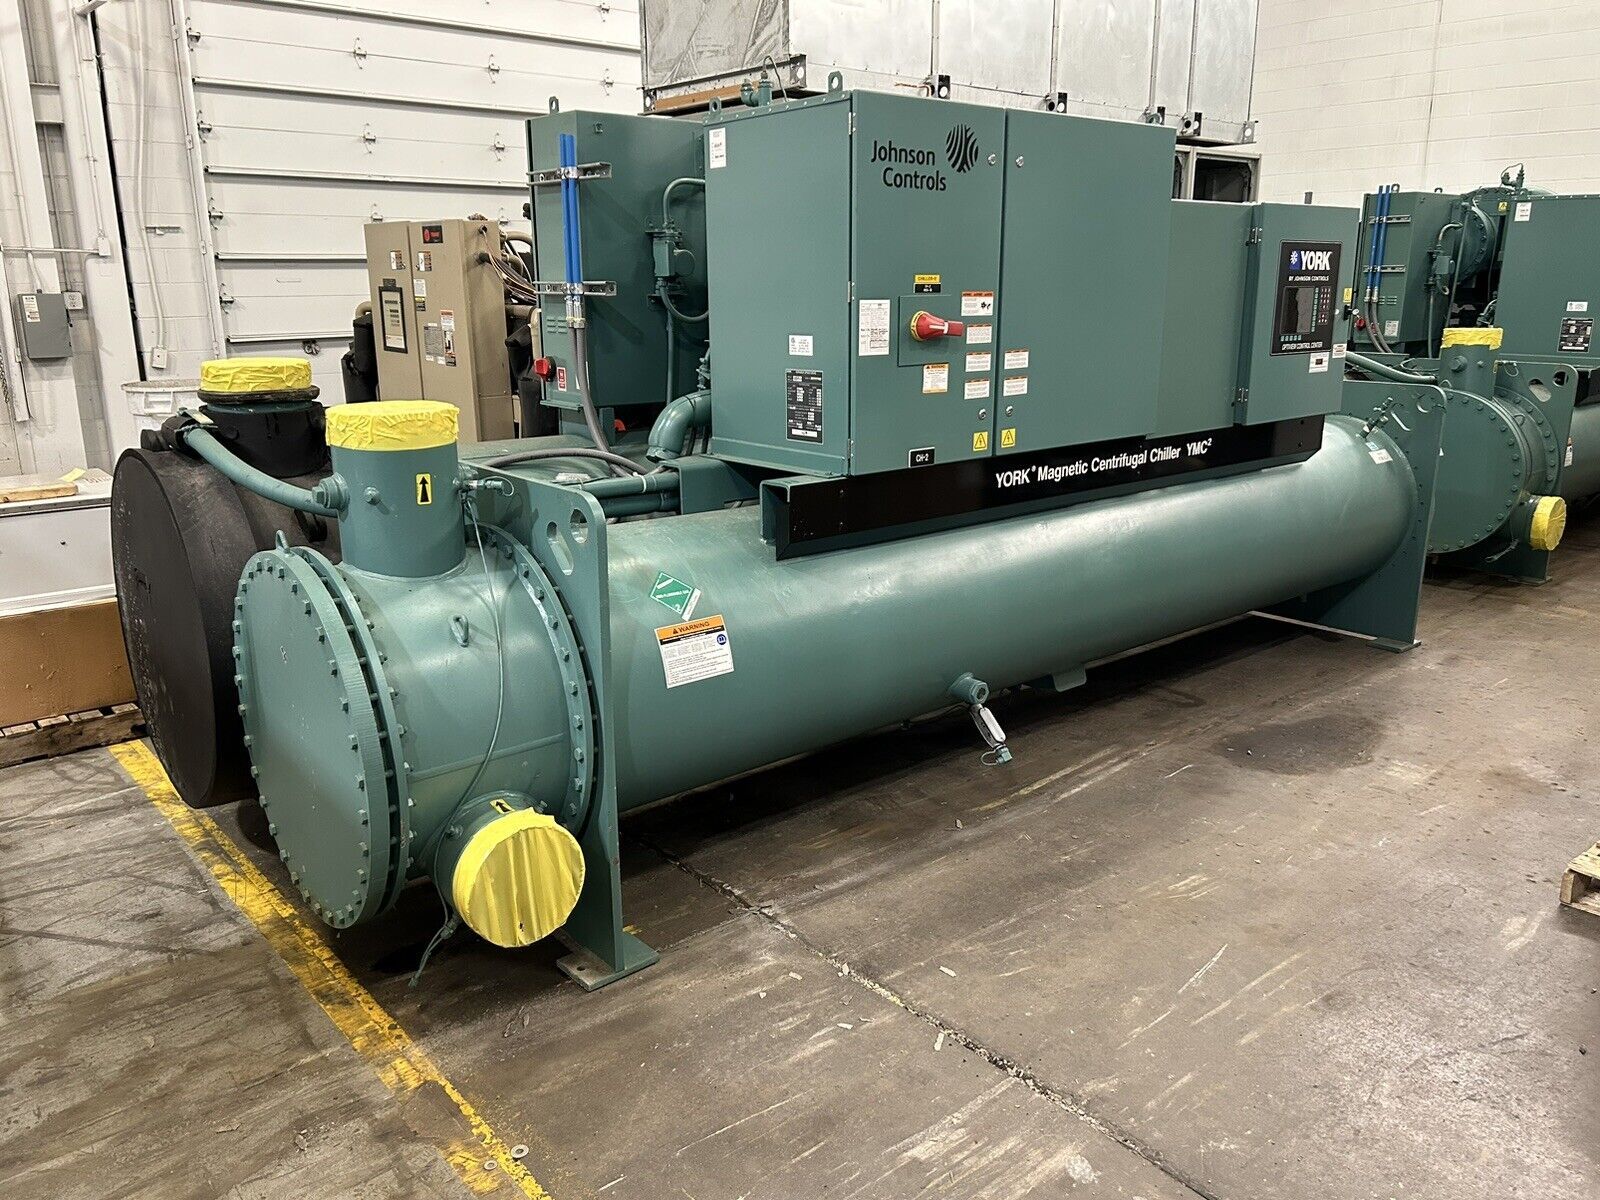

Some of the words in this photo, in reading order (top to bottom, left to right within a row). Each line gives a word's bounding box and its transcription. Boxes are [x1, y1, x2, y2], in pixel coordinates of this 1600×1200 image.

[871, 140, 936, 167] Johnson
[882, 167, 947, 191] Controls
[1301, 250, 1333, 271] YORK
[916, 453, 929, 462] CH-2
[1037, 459, 1089, 482] Magnetic
[1090, 449, 1147, 473] Centrifugal
[1149, 447, 1182, 463] Chiller
[674, 603, 681, 612] 2
[677, 621, 710, 633] WARNING
